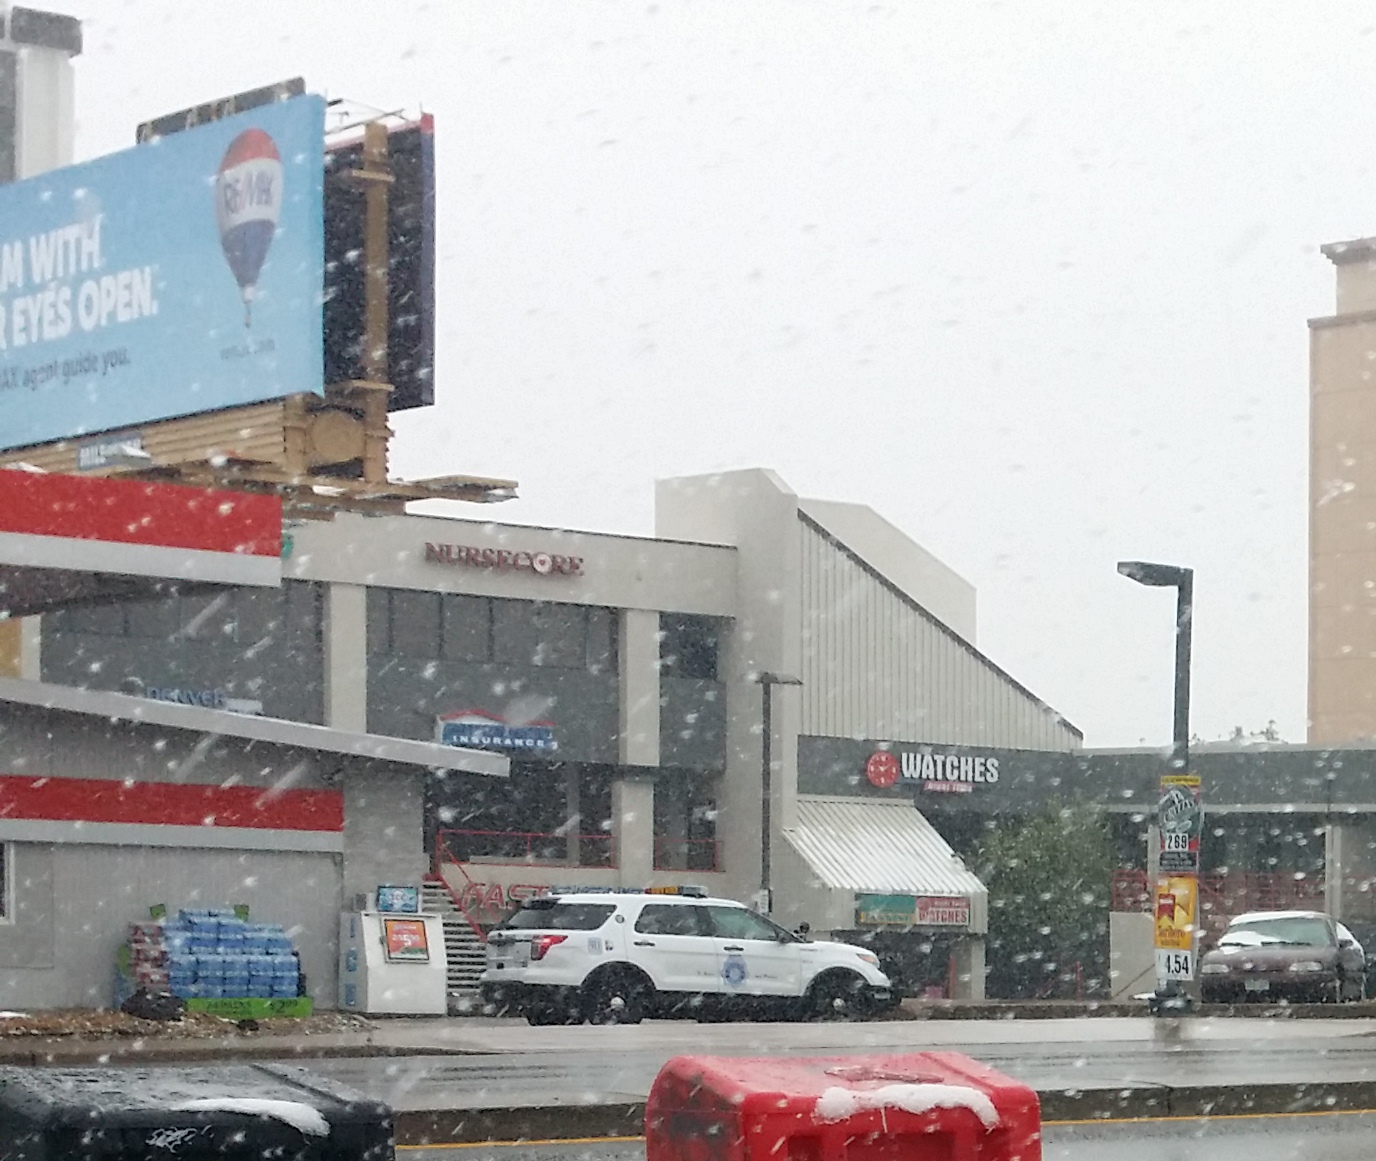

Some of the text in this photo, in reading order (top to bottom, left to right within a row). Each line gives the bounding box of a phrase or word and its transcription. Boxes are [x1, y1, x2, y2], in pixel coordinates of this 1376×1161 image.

[30, 215, 102, 285] WITH
[12, 284, 72, 347] EYES
[78, 266, 159, 332] OPEN.
[425, 542, 585, 577] NURSECORE
[452, 735, 545, 747] INSURANCE
[901, 752, 999, 783] WATCHES
